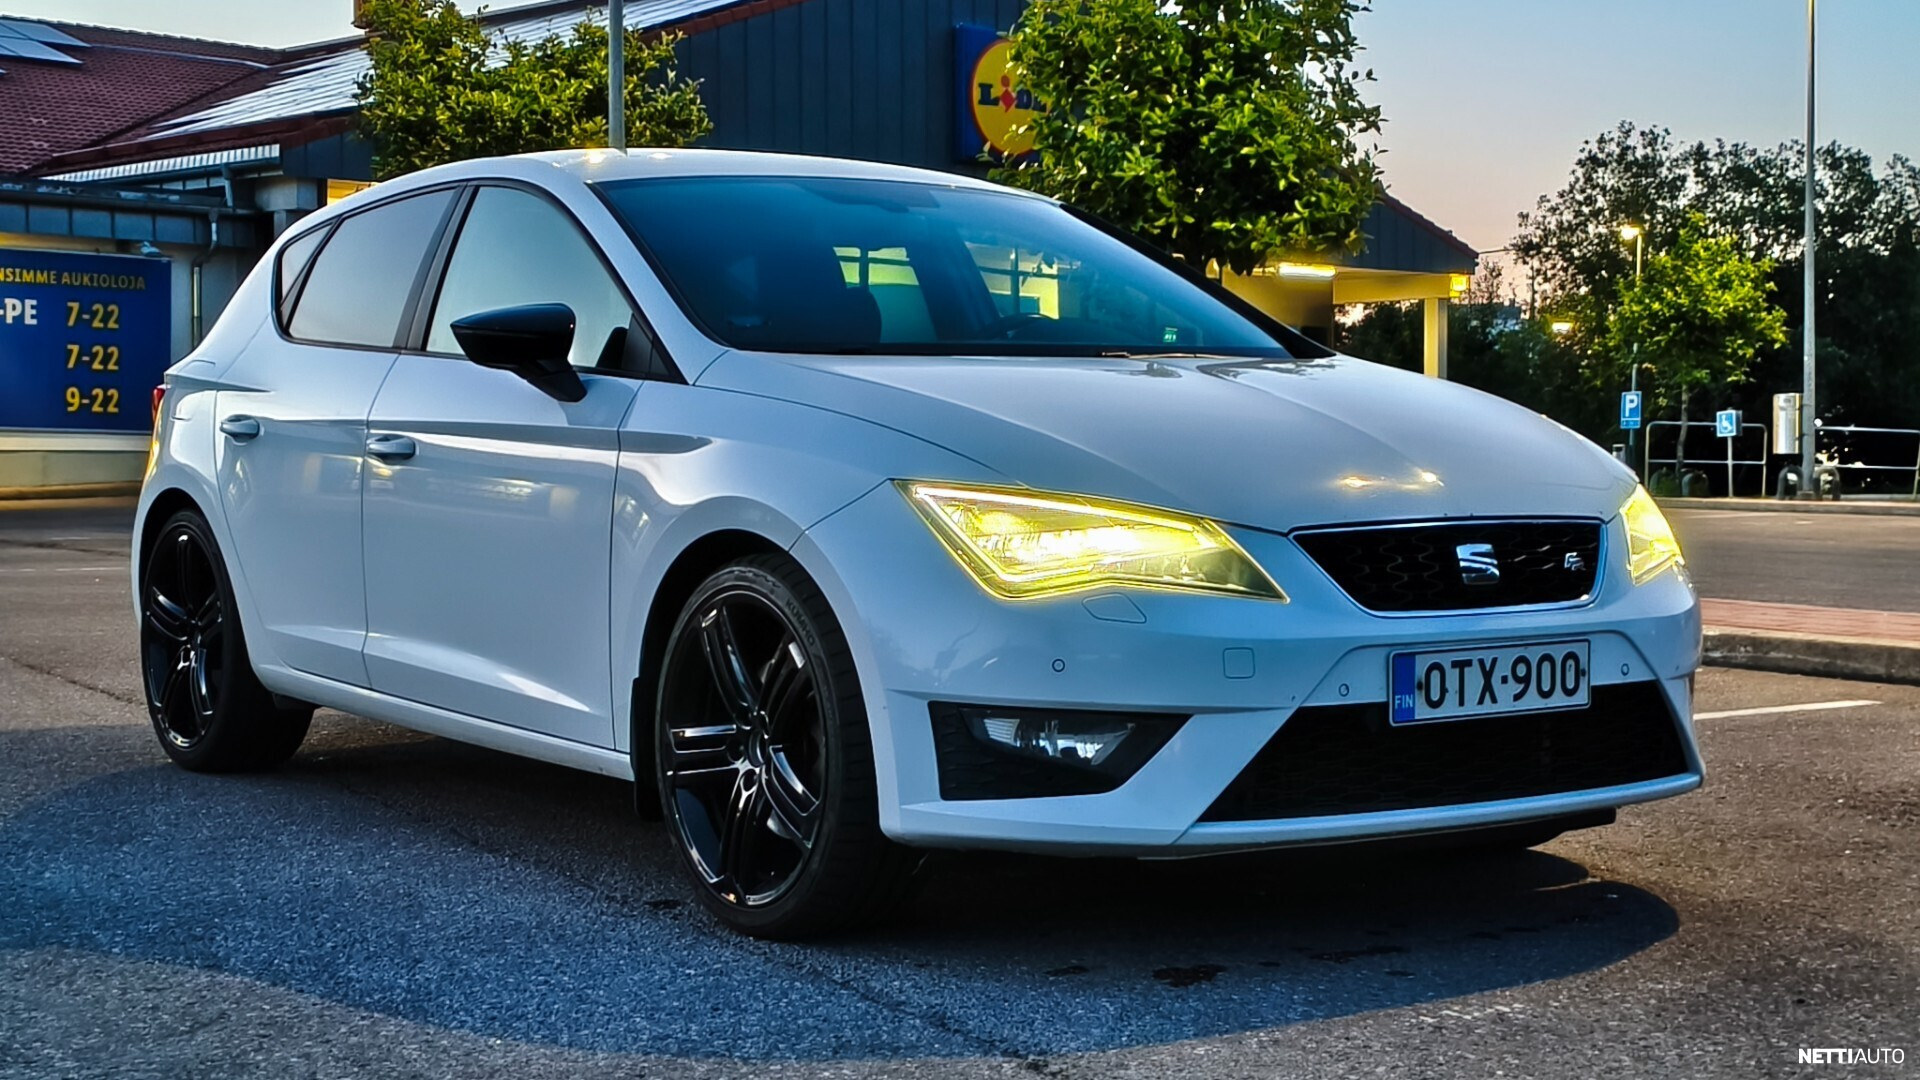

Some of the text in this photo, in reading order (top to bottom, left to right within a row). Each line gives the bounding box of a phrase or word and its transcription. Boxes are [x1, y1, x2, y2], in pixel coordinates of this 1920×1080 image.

[61, 272, 146, 289] AUKIOLOJA
[66, 301, 120, 329] 7-22
[66, 344, 119, 370] 7-22
[66, 386, 119, 413] 9-22
[1625, 395, 1638, 417] P
[1424, 651, 1580, 709] OTX-900
[1394, 694, 1414, 710] FIN
